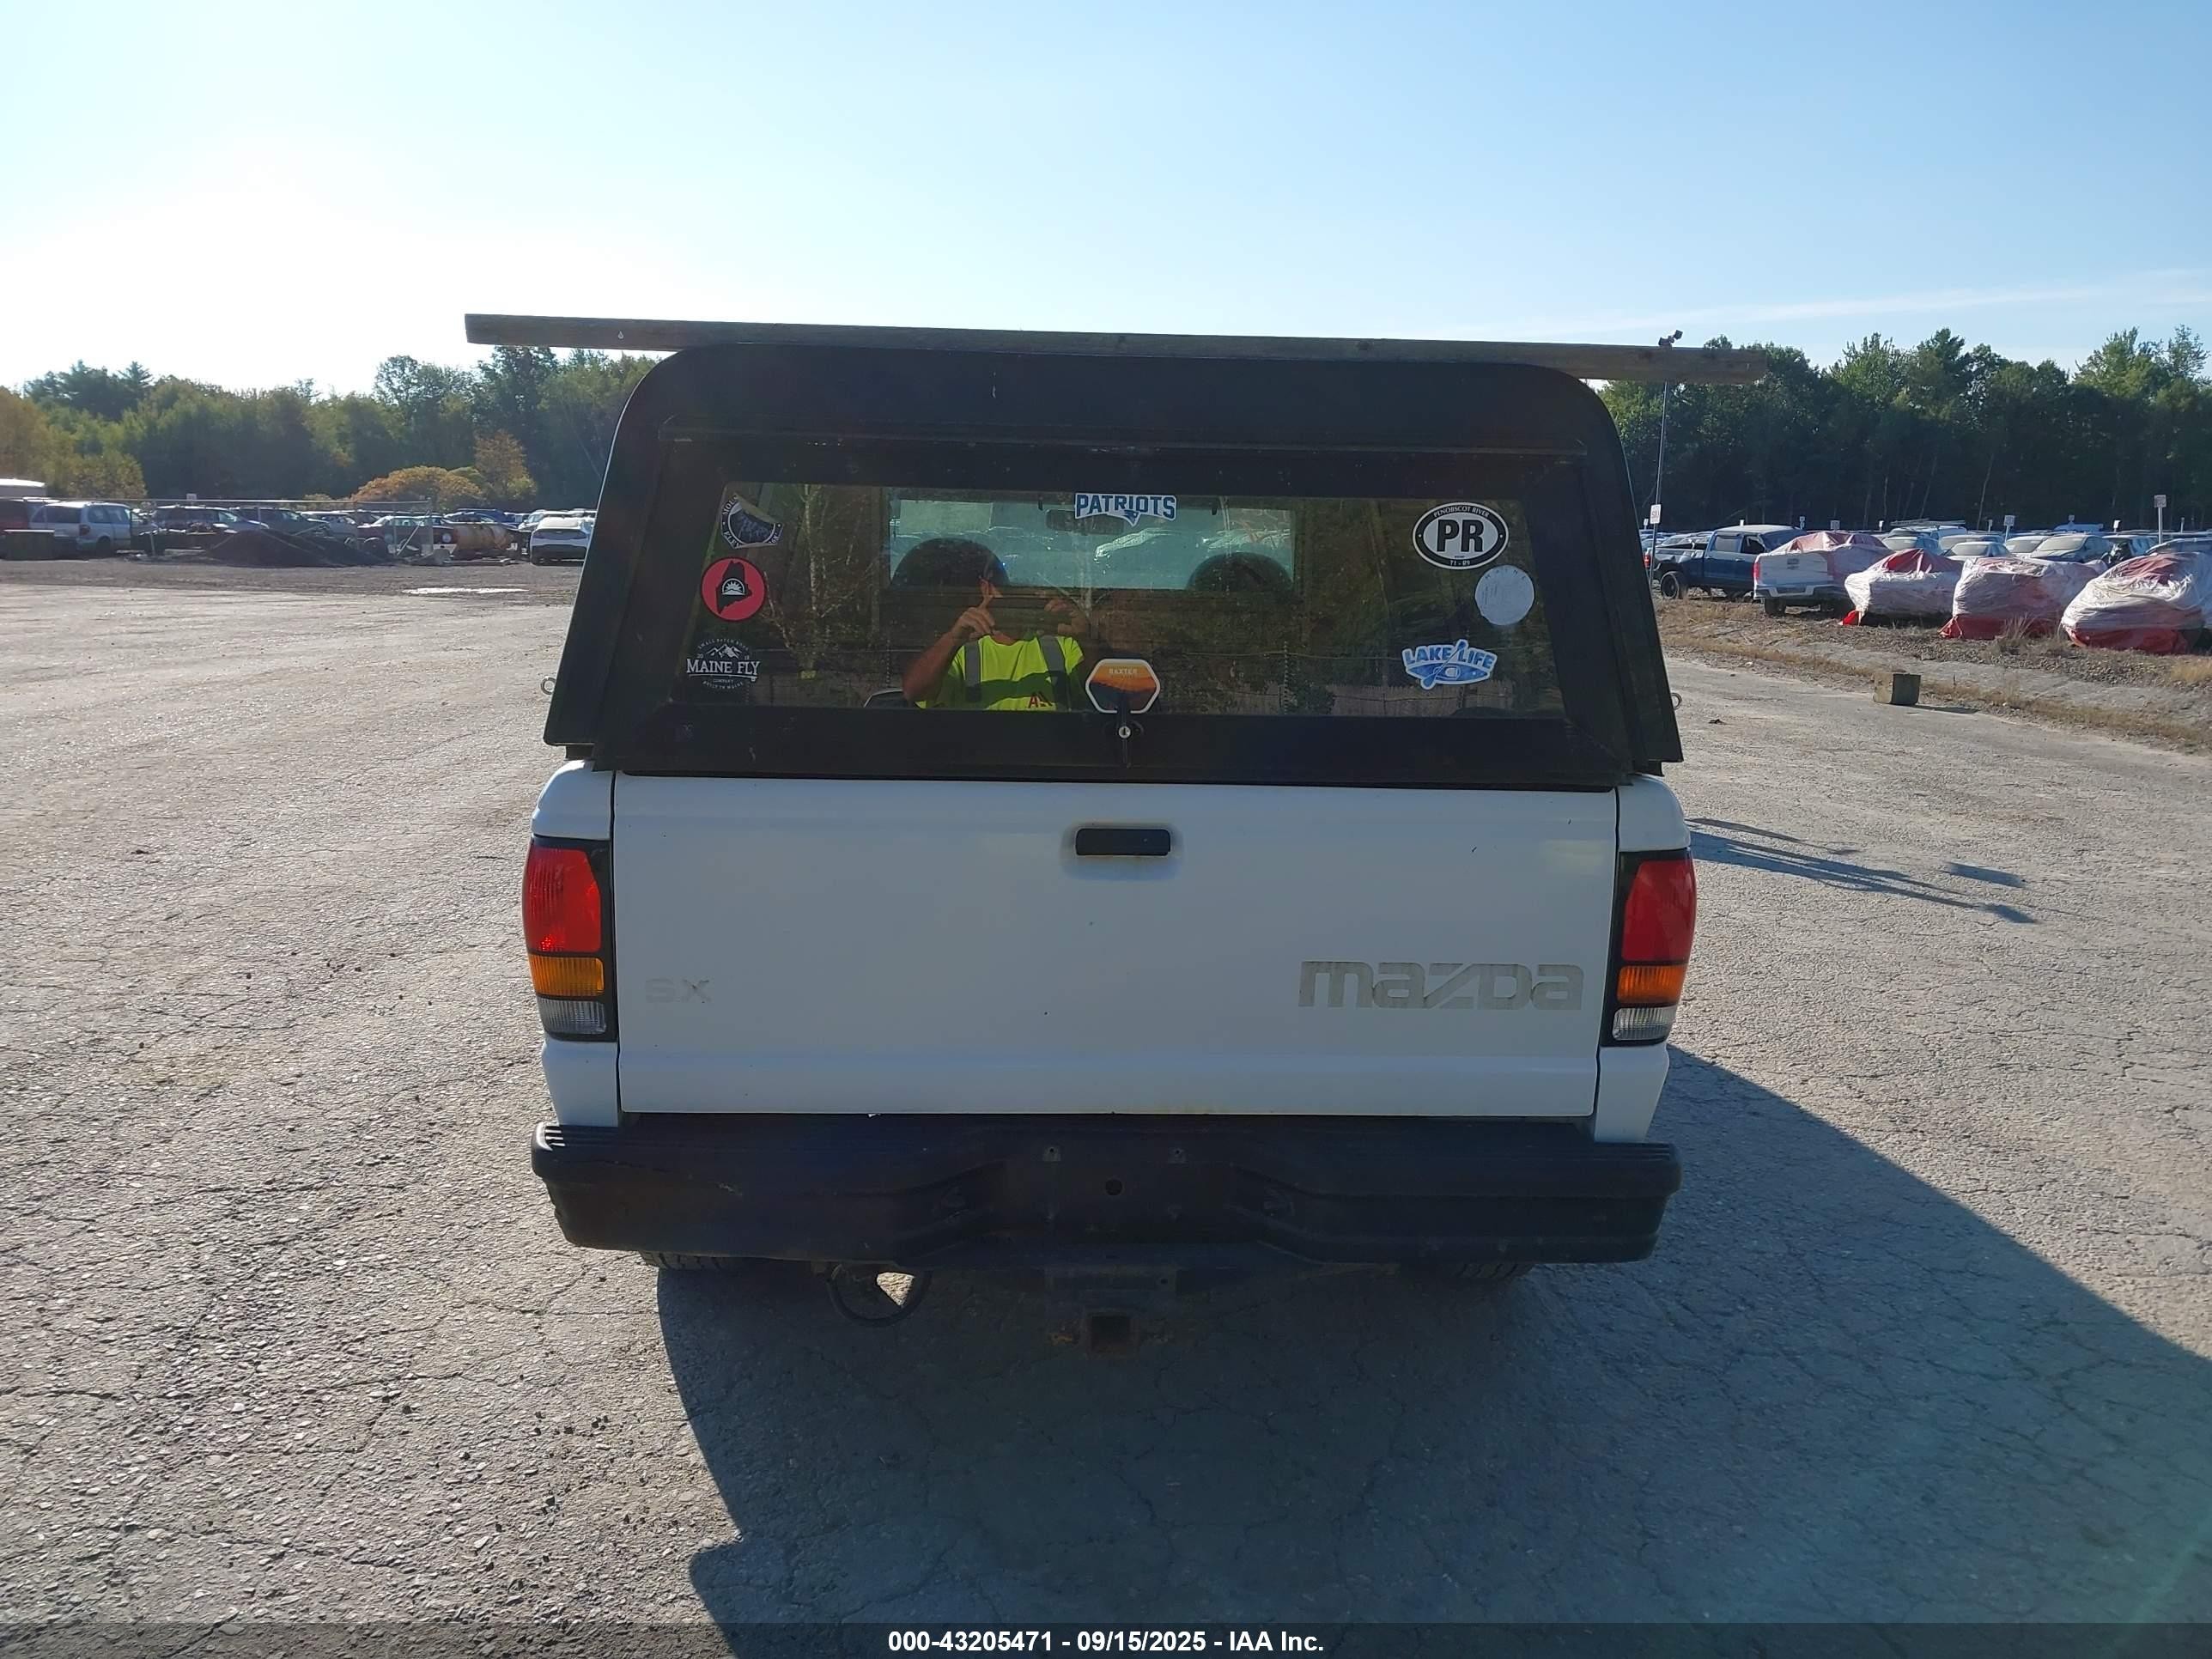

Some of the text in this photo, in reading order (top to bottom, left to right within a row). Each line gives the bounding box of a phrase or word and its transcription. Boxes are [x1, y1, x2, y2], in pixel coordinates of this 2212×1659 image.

[1076, 494, 1176, 519] PATRIOTS
[1433, 505, 1490, 518] PENOBSCOT RIVER
[1437, 519, 1485, 552] PR
[686, 658, 761, 676] MAINE FLY
[1402, 647, 1495, 669] LAKE LIFE
